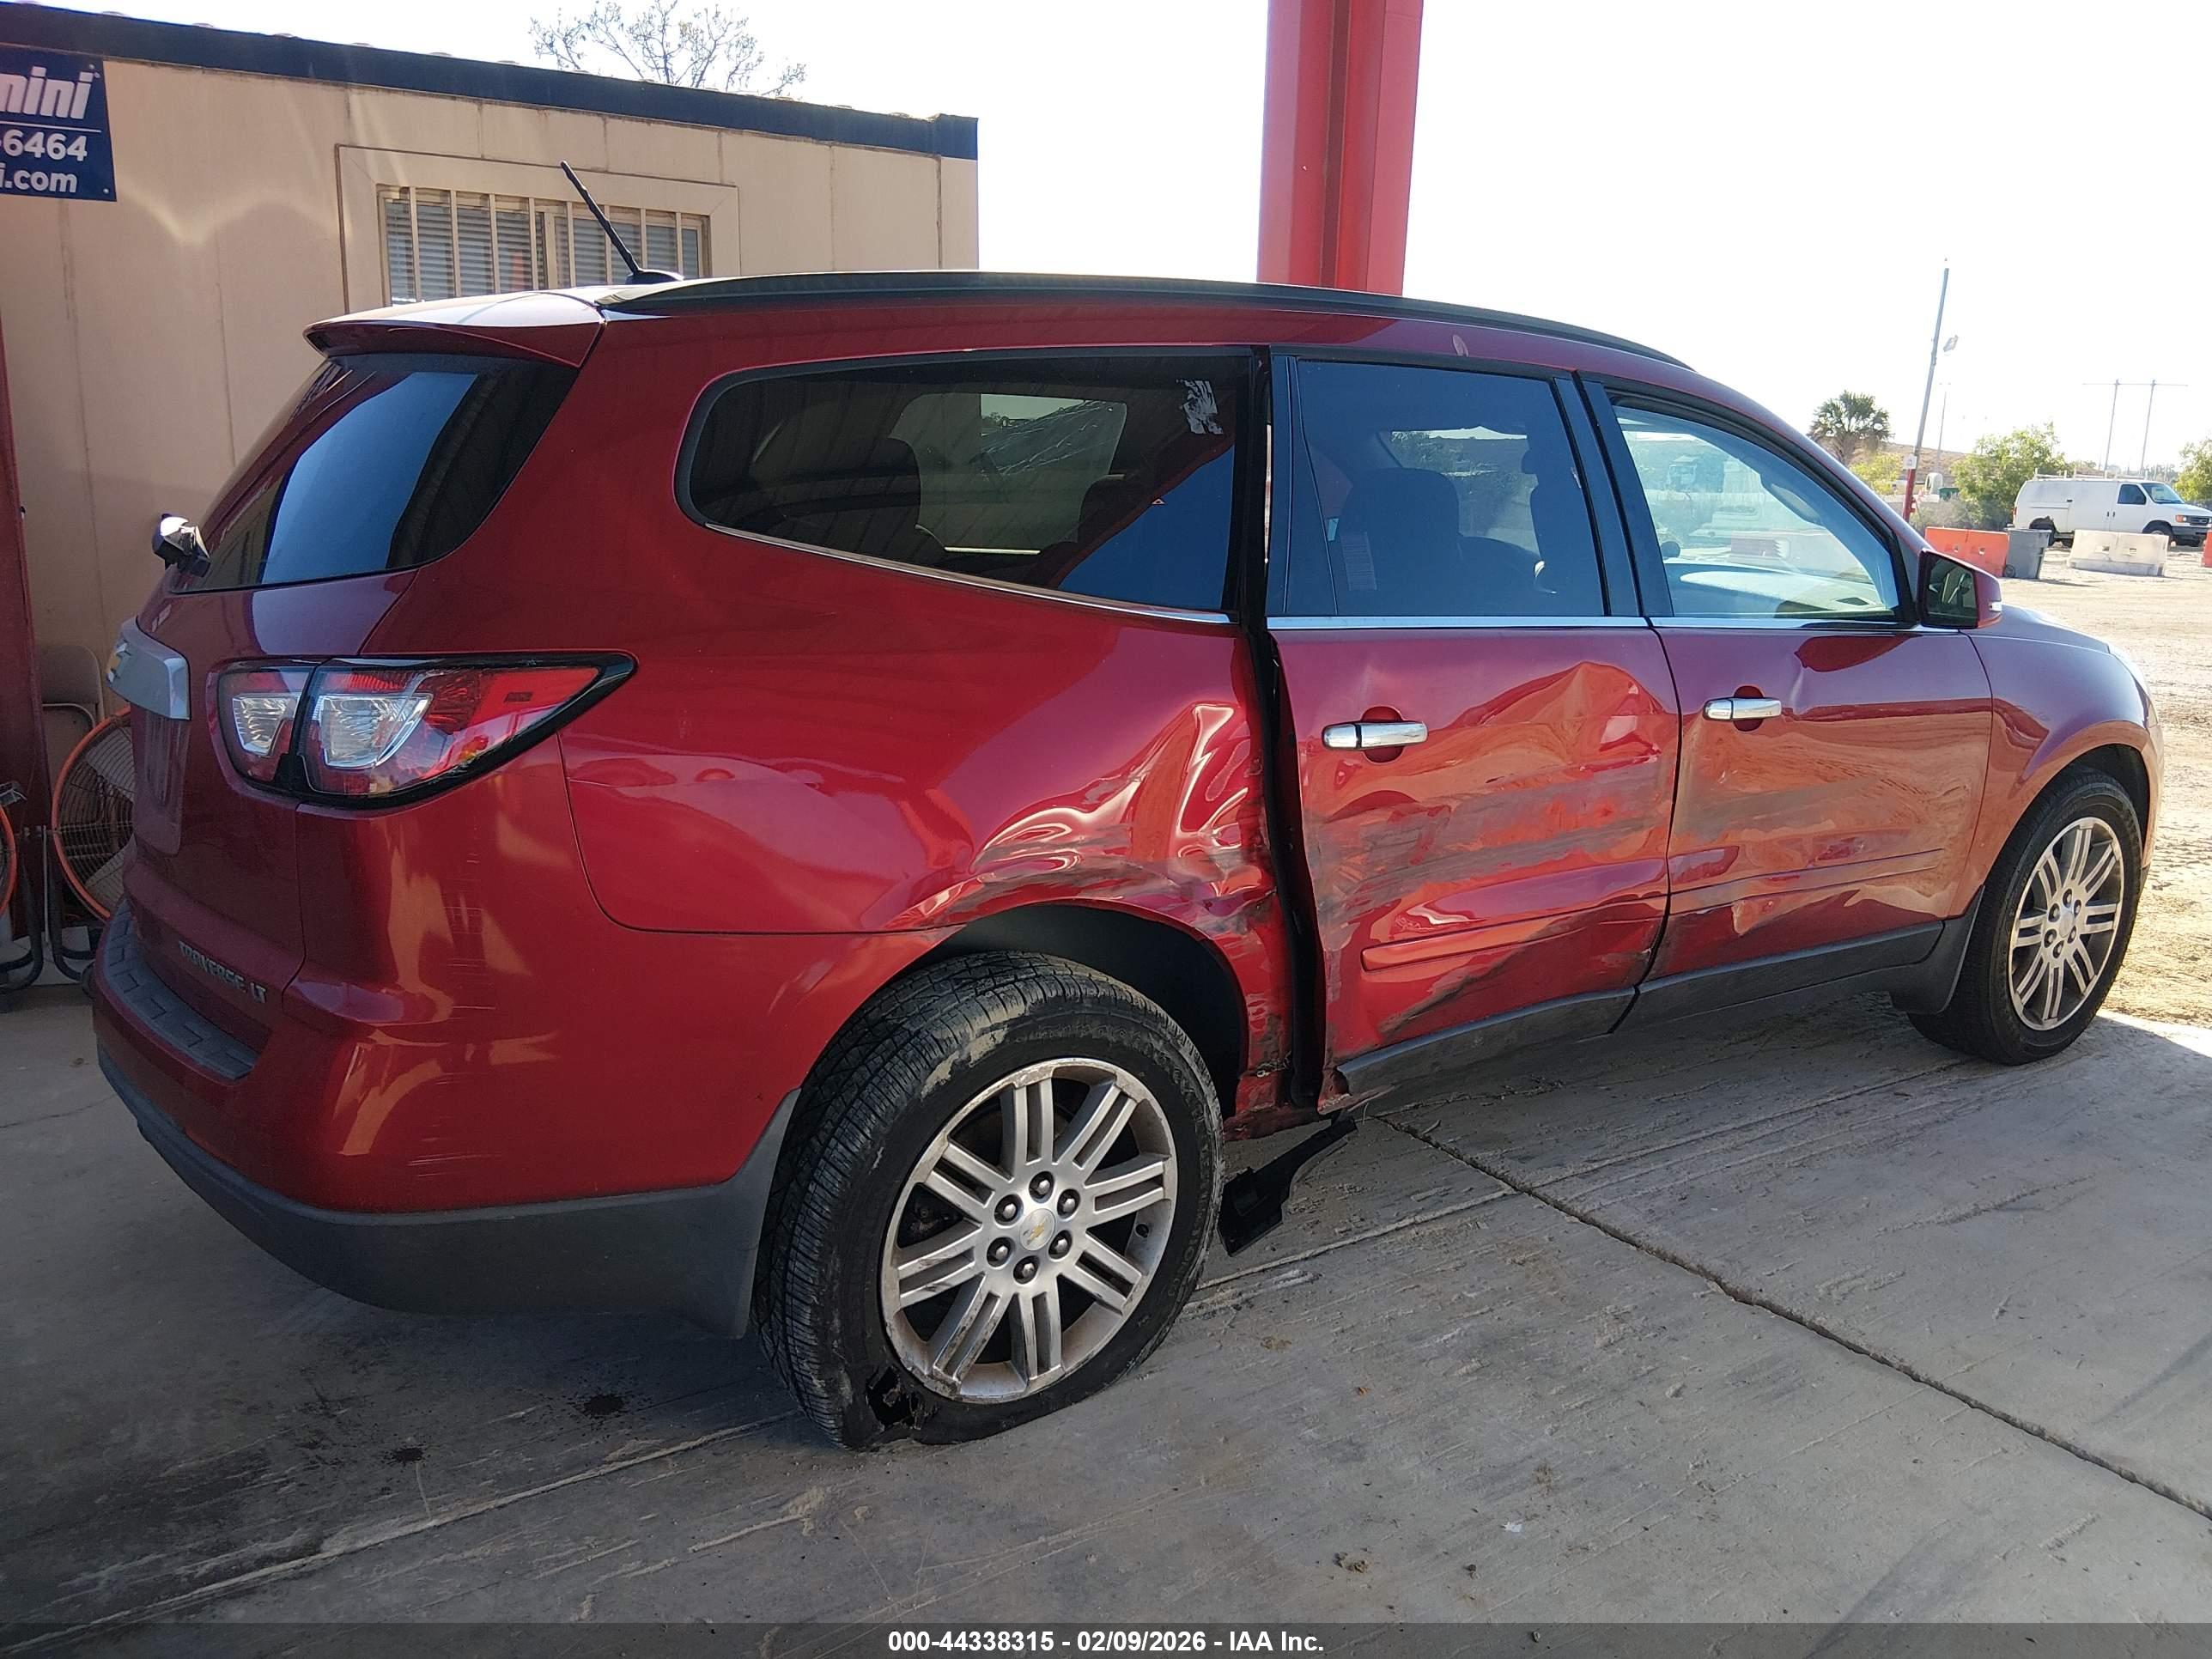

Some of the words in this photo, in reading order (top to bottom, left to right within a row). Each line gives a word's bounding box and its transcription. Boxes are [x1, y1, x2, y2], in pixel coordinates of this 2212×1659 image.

[0, 129, 88, 161] 6464
[178, 940, 248, 994] TRAVERSE
[249, 981, 267, 1004] LT
